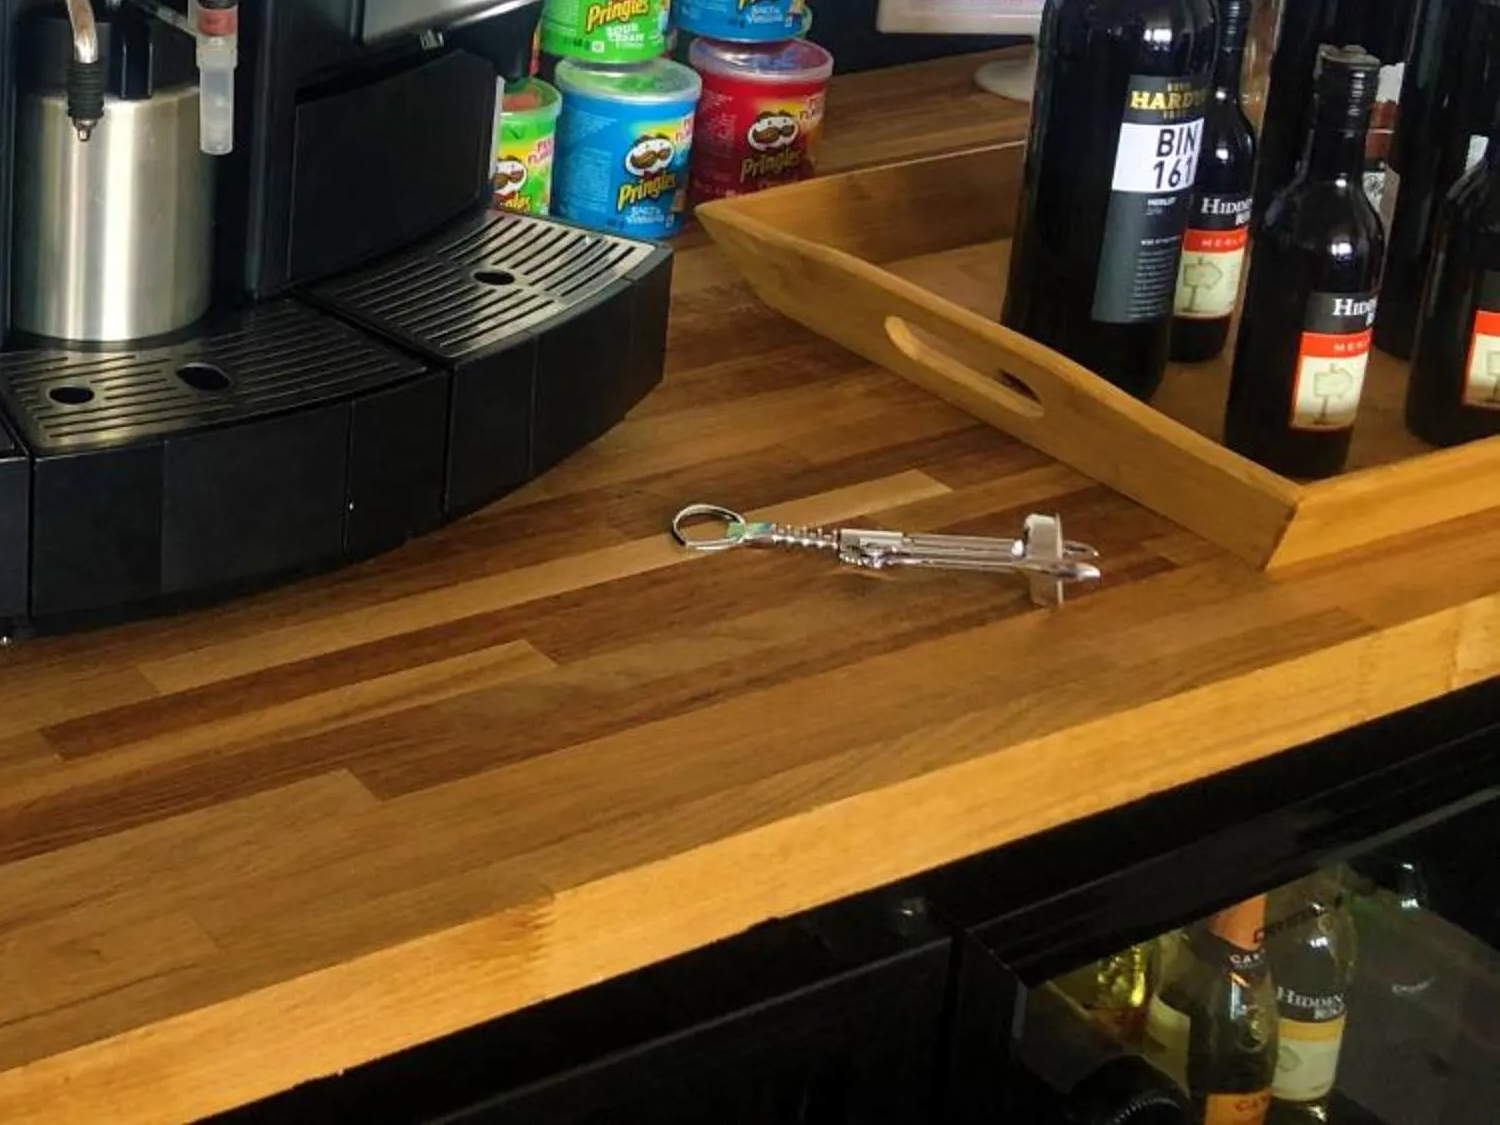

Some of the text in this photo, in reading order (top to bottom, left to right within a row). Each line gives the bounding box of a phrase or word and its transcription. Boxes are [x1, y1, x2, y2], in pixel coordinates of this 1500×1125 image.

[1156, 124, 1199, 158] BIN
[740, 147, 803, 183] Pringles
[1153, 155, 1193, 189] 161
[617, 173, 676, 212] Pringles
